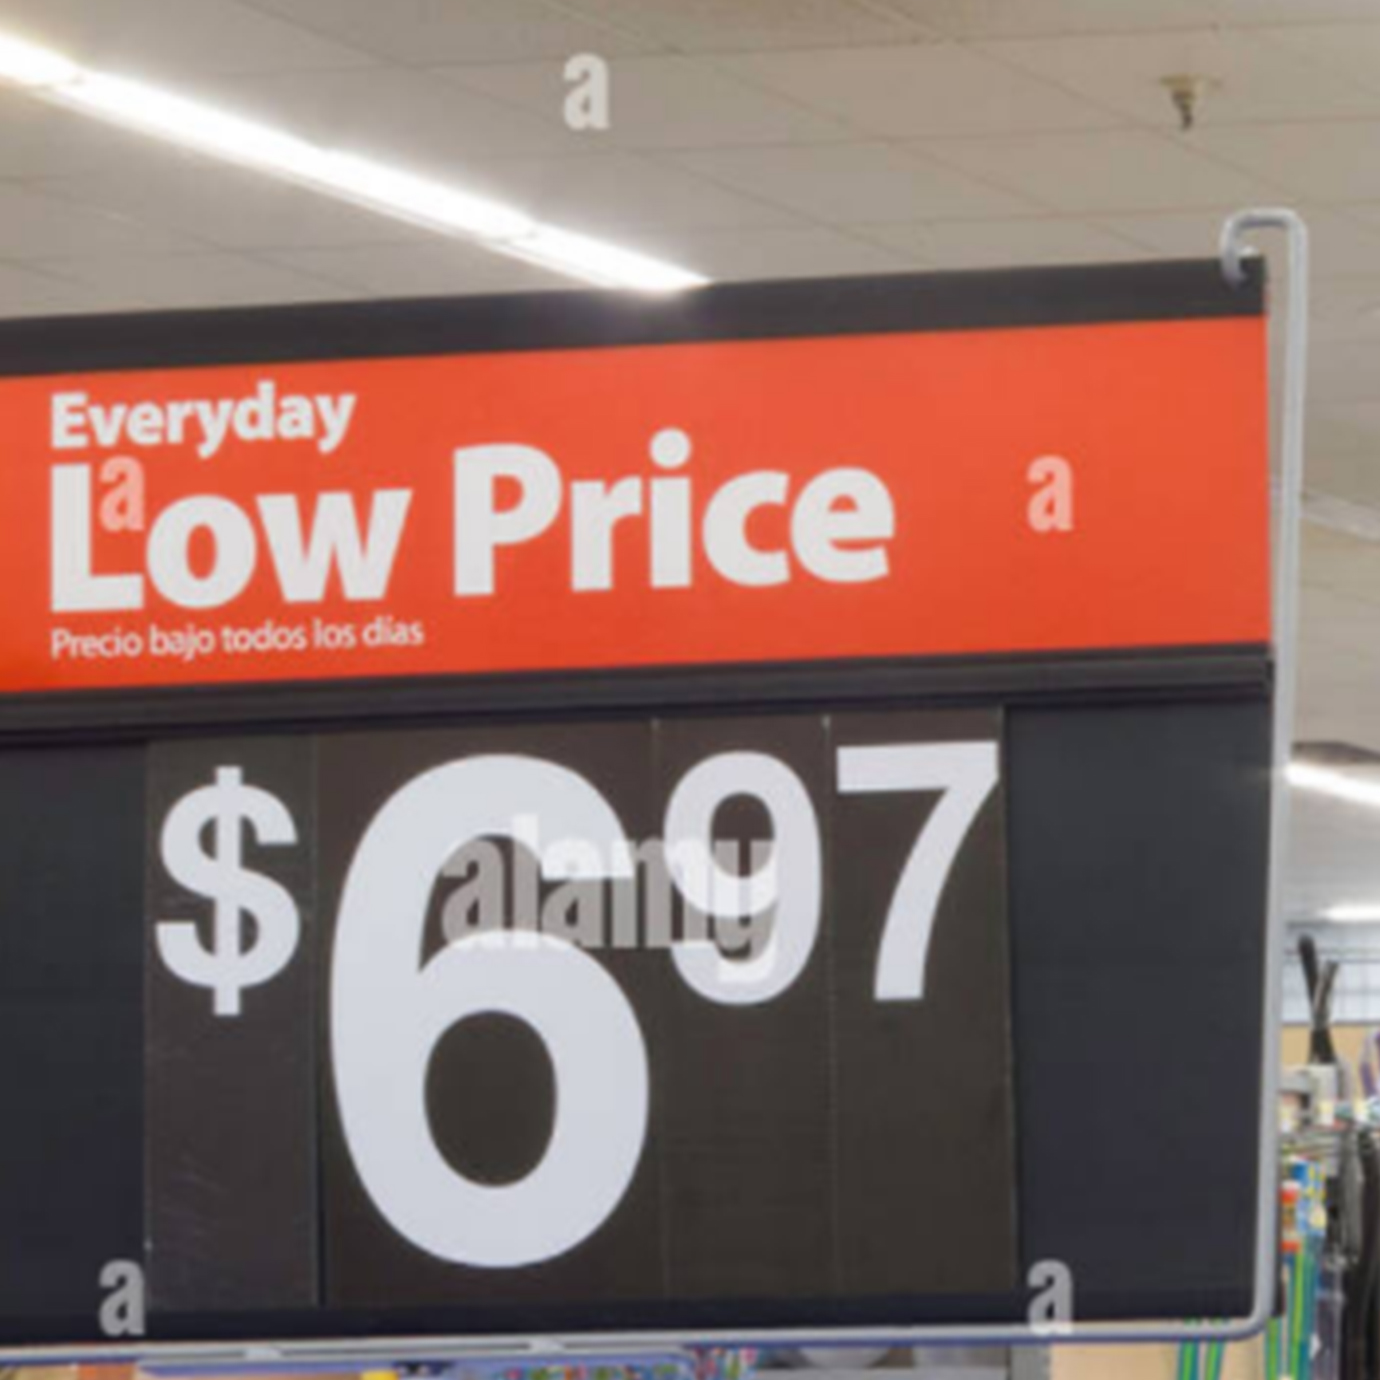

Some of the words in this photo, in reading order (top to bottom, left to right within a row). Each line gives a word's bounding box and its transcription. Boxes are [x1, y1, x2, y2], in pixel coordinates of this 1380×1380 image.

[51, 381, 356, 459] Everyday
[51, 463, 413, 613] Low
[453, 428, 895, 597] Price
[51, 624, 142, 659] Precio
[150, 624, 215, 661] bajo
[220, 618, 306, 651] todos
[313, 617, 356, 647] los
